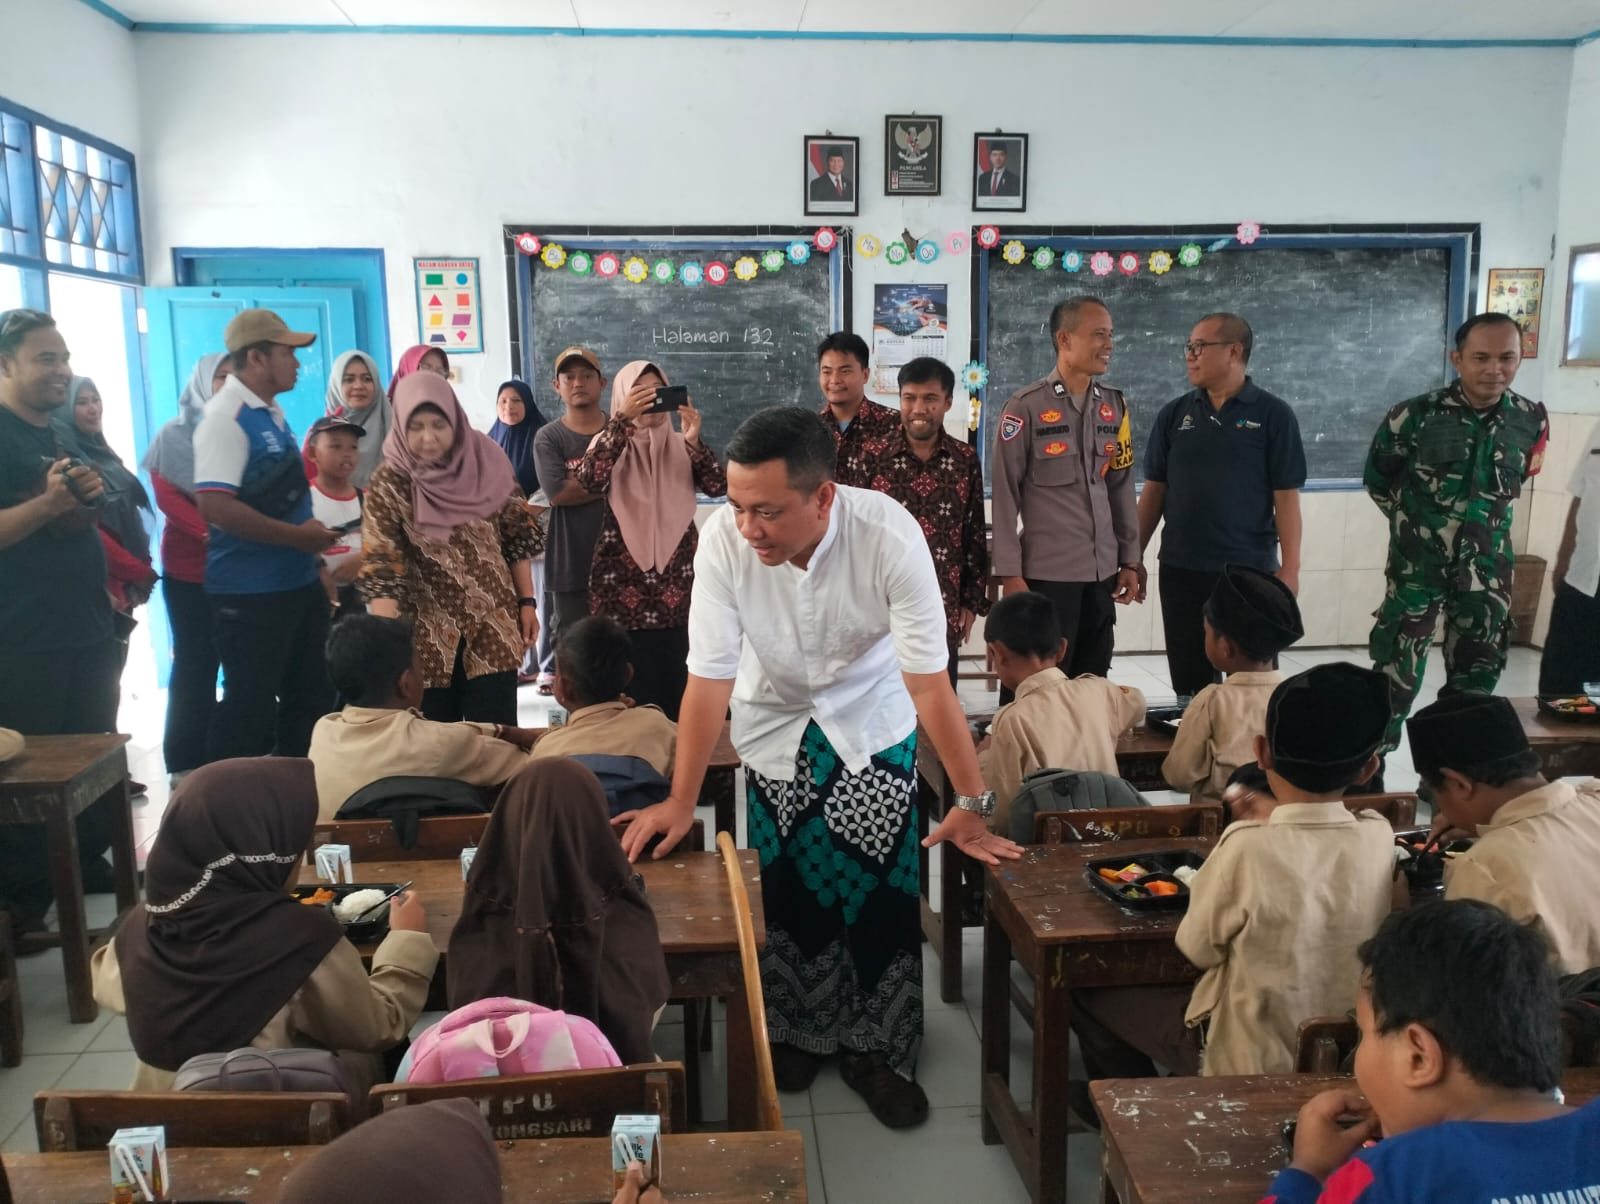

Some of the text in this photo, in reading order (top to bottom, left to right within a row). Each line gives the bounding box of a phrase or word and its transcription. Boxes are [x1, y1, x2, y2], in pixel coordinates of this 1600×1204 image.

[652, 325, 775, 346] Halaman 132
[494, 1117, 592, 1139] ONGSARI
